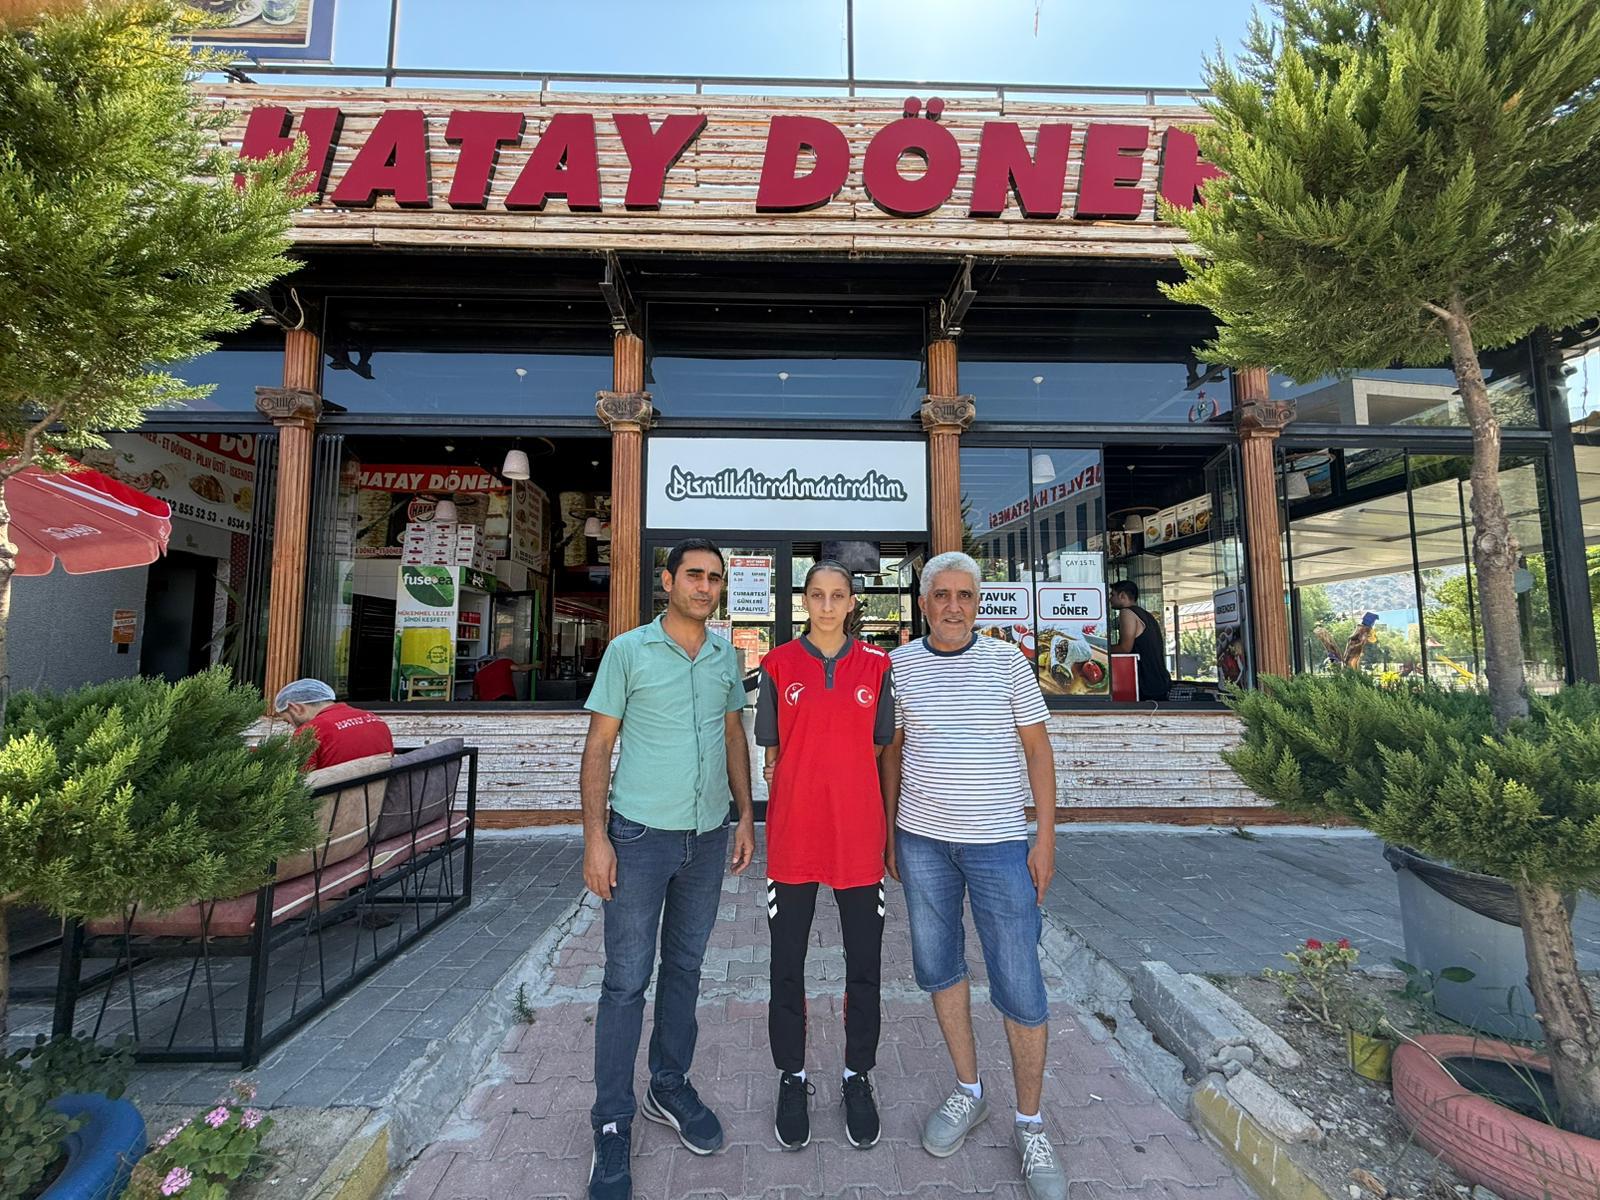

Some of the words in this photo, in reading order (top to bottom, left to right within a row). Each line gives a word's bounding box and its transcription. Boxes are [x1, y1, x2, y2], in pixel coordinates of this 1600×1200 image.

[235, 106, 708, 211] HATAY
[358, 471, 424, 490] HATAY
[178, 502, 194, 516] 855
[195, 507, 206, 520] 52
[980, 592, 1016, 602] TAVUK
[1063, 592, 1077, 602] ET
[978, 603, 1017, 615] DÖNER
[1052, 603, 1088, 616] DÖNER
